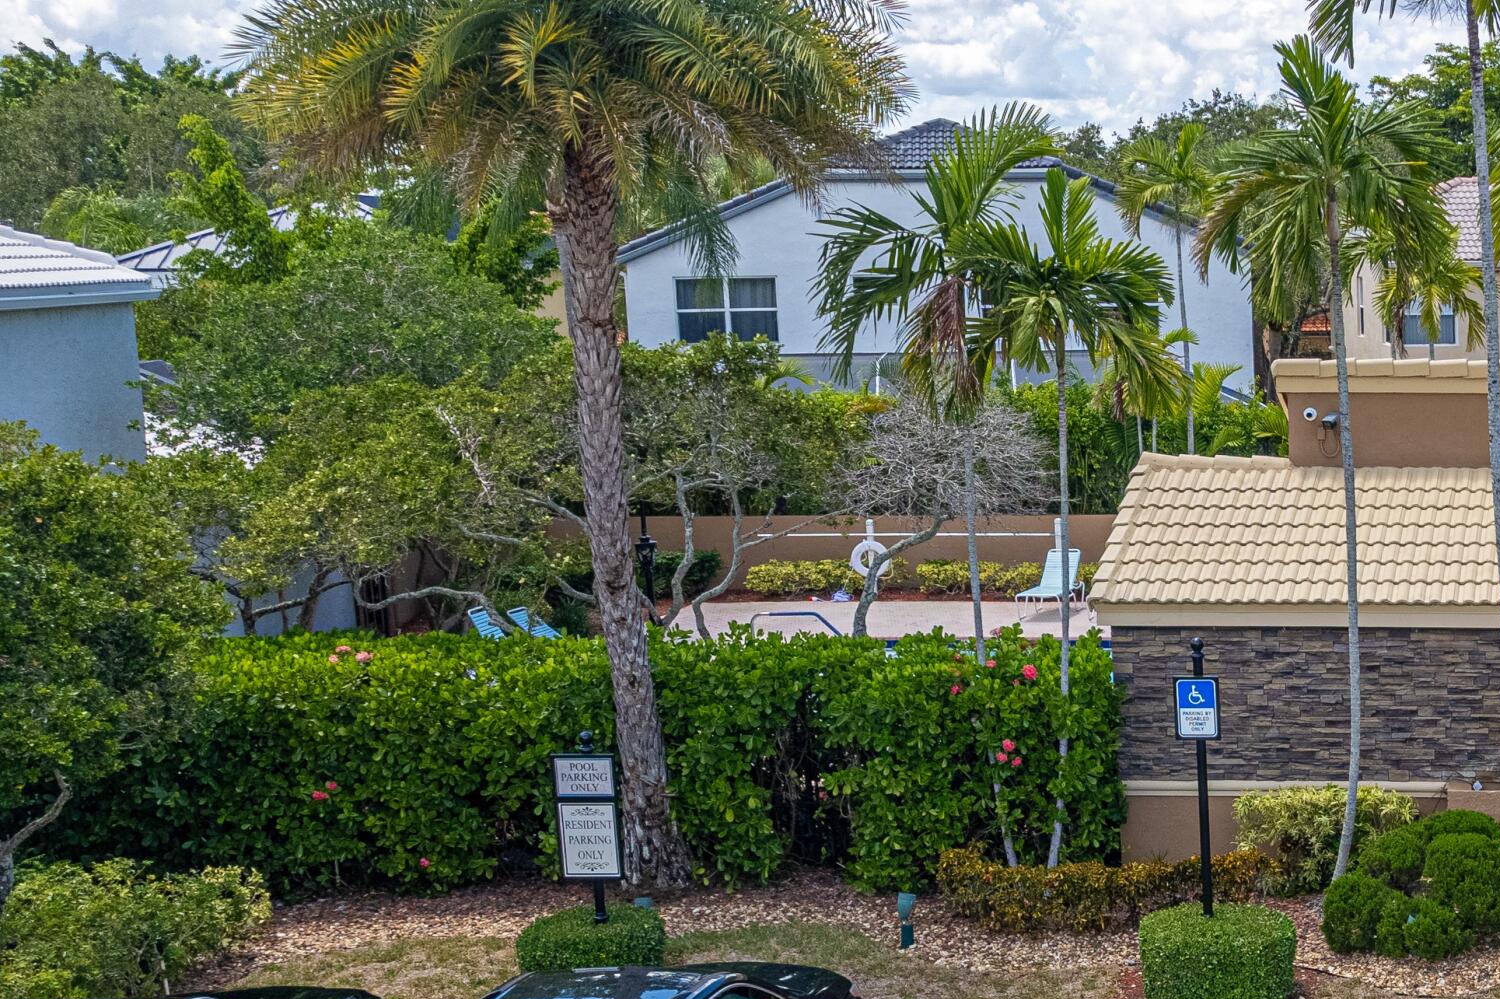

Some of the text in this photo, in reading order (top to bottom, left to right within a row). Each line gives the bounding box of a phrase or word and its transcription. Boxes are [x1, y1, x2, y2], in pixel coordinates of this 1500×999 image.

[569, 762, 598, 771] POOL
[561, 772, 608, 782] PARKING
[570, 783, 599, 792] ONLY
[565, 820, 612, 830] RESIDENT
[568, 835, 612, 845] PARKING
[577, 850, 604, 860] ONLY
